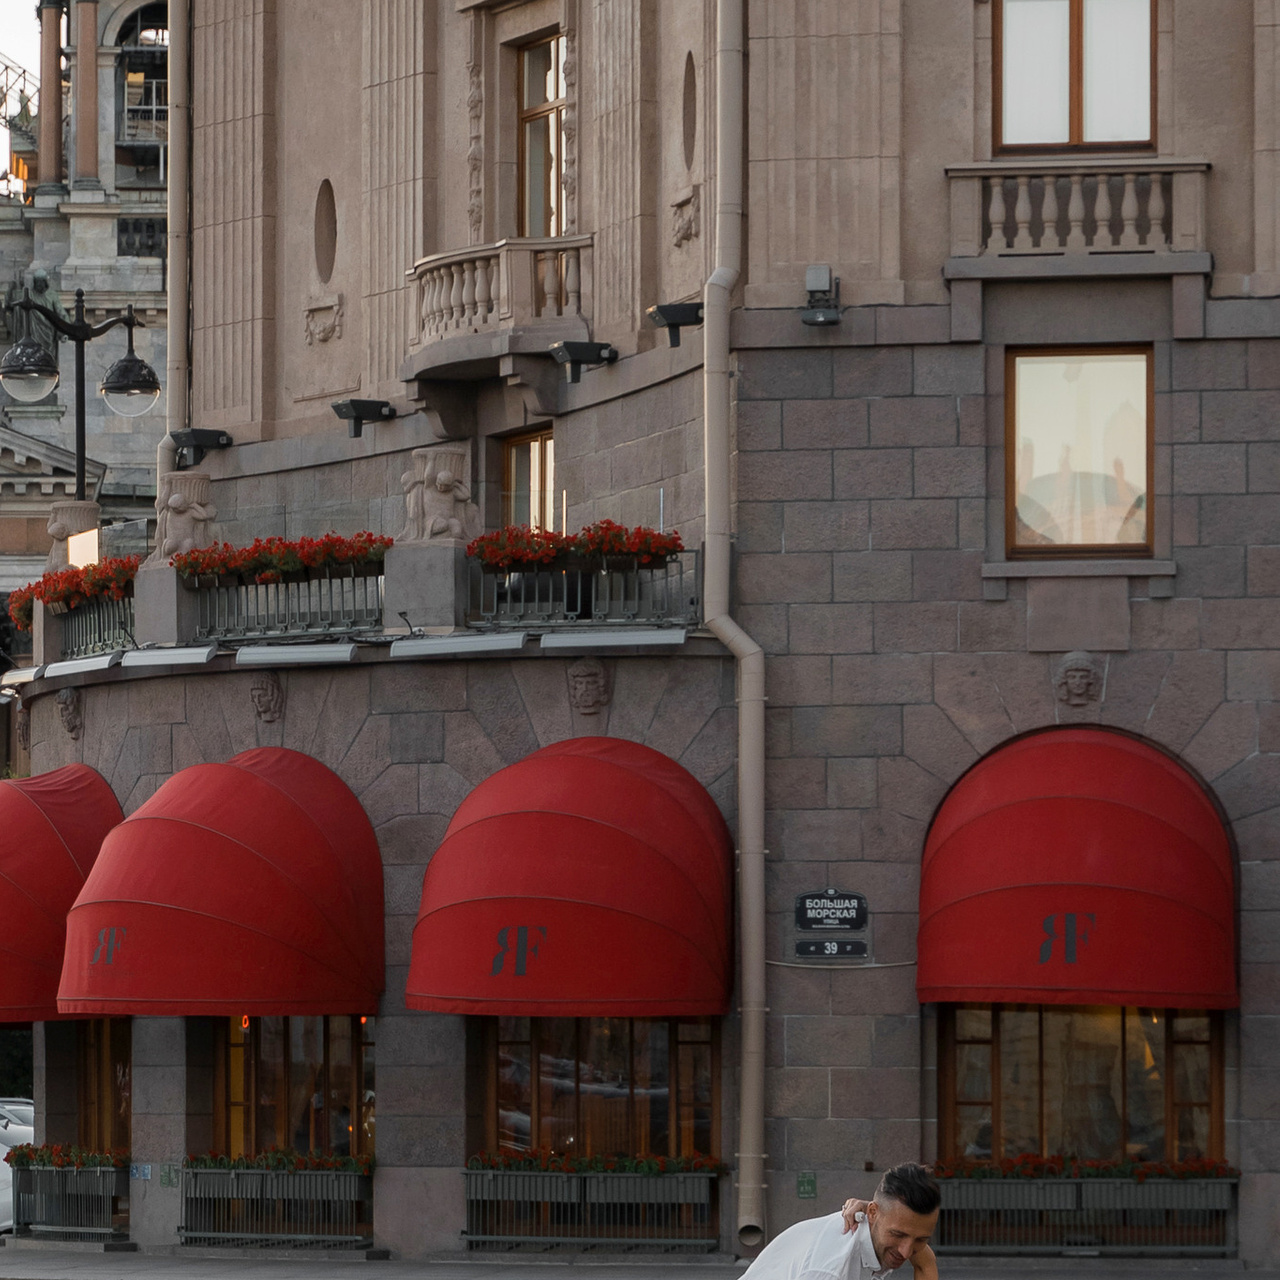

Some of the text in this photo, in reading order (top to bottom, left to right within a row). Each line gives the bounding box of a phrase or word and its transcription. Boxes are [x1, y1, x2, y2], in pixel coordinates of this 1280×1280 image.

[805, 898, 858, 908] БОЛЬШАЯ
[807, 909, 857, 918] МОРСКАЯ
[824, 941, 838, 955] 39
